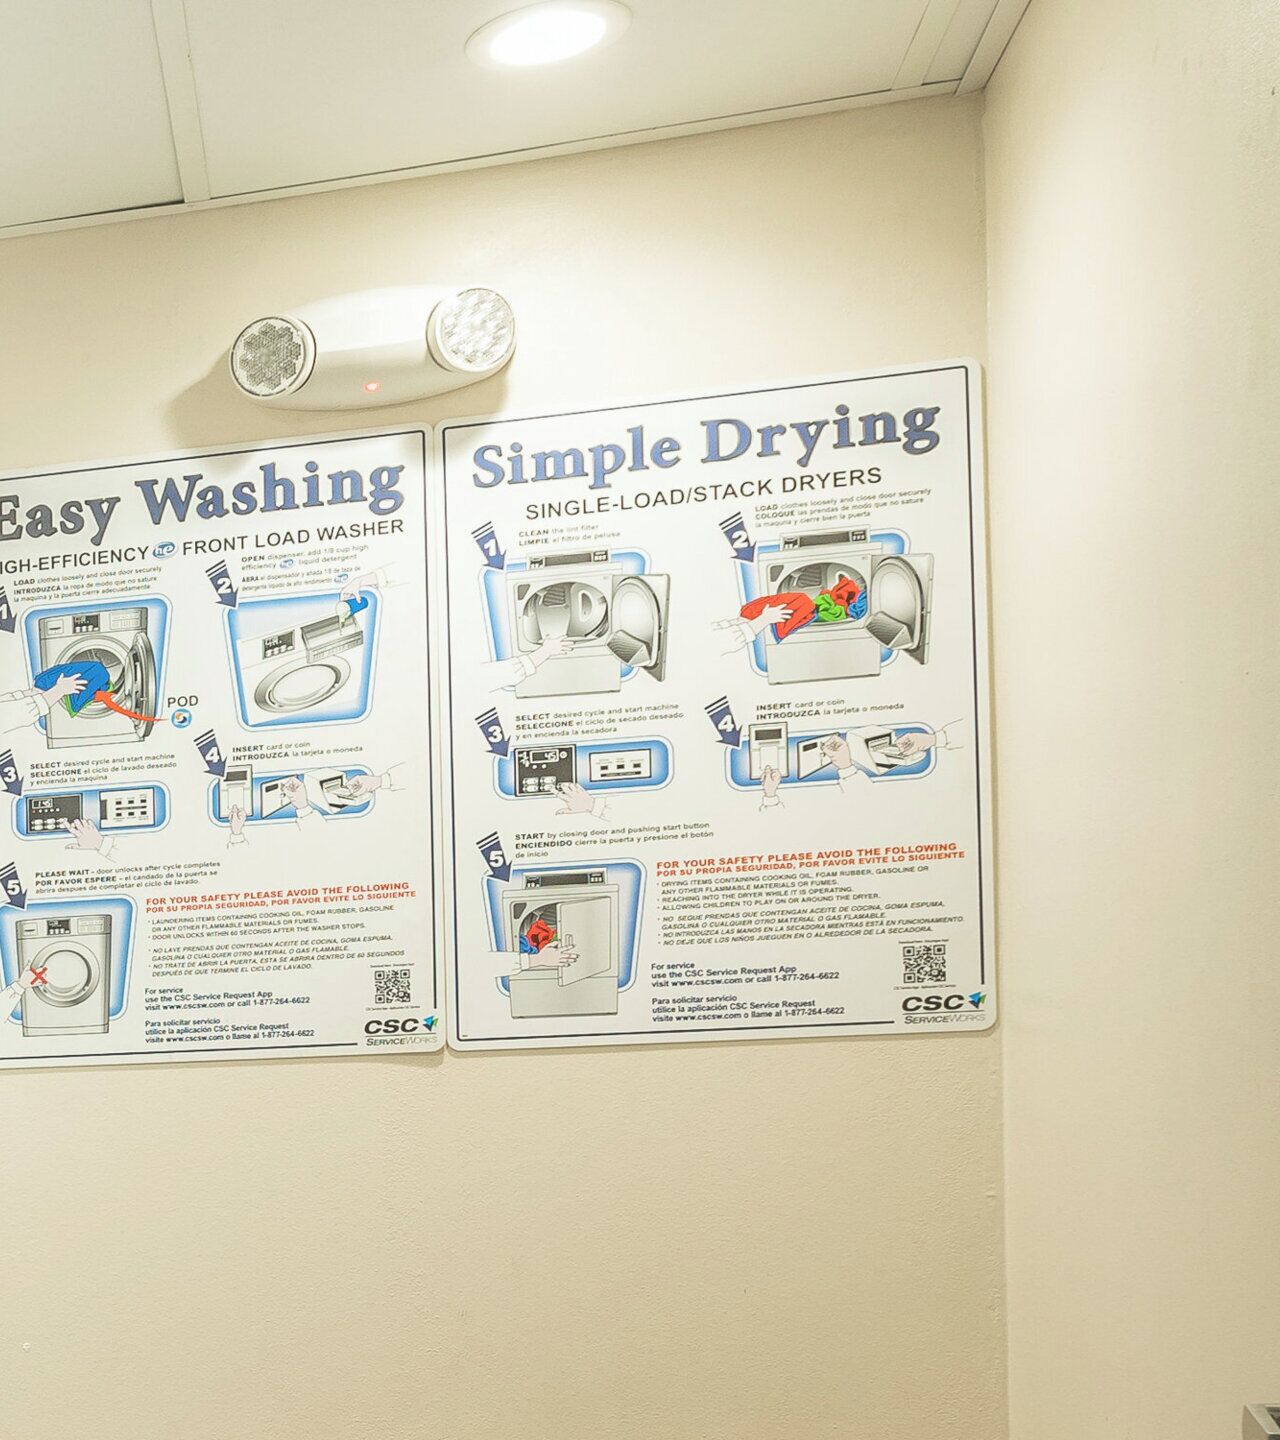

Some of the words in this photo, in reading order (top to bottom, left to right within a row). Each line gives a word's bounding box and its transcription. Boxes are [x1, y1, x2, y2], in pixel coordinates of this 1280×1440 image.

[472, 425, 681, 489] Simple
[701, 404, 941, 467] Drying
[135, 460, 406, 526] Washing
[526, 478, 774, 521] SINGLE-LOAD/STACK
[781, 467, 882, 494] DRYERS
[182, 535, 249, 557] FRONT
[254, 528, 311, 550] LOAD
[317, 519, 405, 542] WASHER
[732, 531, 749, 548] 2
[485, 540, 498, 556] 1
[217, 577, 231, 594] 2
[167, 695, 200, 709] POD
[720, 716, 735, 731] 4
[487, 725, 504, 743] 3
[204, 749, 220, 762] 4
[231, 744, 263, 753] INSERT
[266, 743, 283, 751] card
[29, 760, 61, 770] SELECT
[62, 758, 89, 768] desired
[90, 757, 109, 767] cycle
[111, 756, 125, 764] and
[126, 754, 143, 763] start
[144, 752, 175, 761] machine
[3, 766, 16, 783] 3
[514, 831, 544, 840] START
[546, 830, 556, 840] by
[558, 828, 588, 839] closing
[589, 827, 608, 836] door
[610, 826, 626, 835] and
[627, 824, 660, 835] pushing
[662, 823, 681, 831] start
[682, 821, 710, 830] button
[489, 850, 505, 866] 5
[656, 859, 679, 869] FOR
[683, 857, 715, 868] YOUR
[718, 854, 763, 865] SAFETY
[767, 851, 812, 862] PLEASE
[816, 849, 852, 859] AVOID
[857, 847, 880, 857] THE
[884, 843, 956, 855] FOLLOWING
[6, 880, 21, 896] 5
[145, 896, 166, 906] FOR
[169, 894, 197, 904] YOUR
[200, 892, 239, 902] SAFETY
[243, 889, 283, 900] PLEASE
[286, 887, 318, 897] AVOID
[322, 886, 342, 895] THE
[345, 882, 409, 893] FOLLOWING
[650, 962, 664, 970] For
[666, 962, 695, 970] service
[651, 979, 669, 988] visit
[670, 977, 743, 987] www.cscsw.com
[756, 974, 772, 983] call
[774, 971, 839, 982] 1-877-264-6622
[144, 987, 156, 995] For
[159, 994, 172, 1002] the
[173, 994, 191, 1002] CSC
[192, 993, 221, 1001] Service
[222, 991, 255, 1001] Request
[256, 990, 272, 999] App
[144, 1003, 160, 1011] visit
[161, 1001, 225, 1010] www.cscsw.com
[236, 999, 251, 1007] call
[253, 996, 310, 1006] 1-877-264-6622
[902, 992, 965, 1012] CSC
[364, 1017, 419, 1035] CSC
